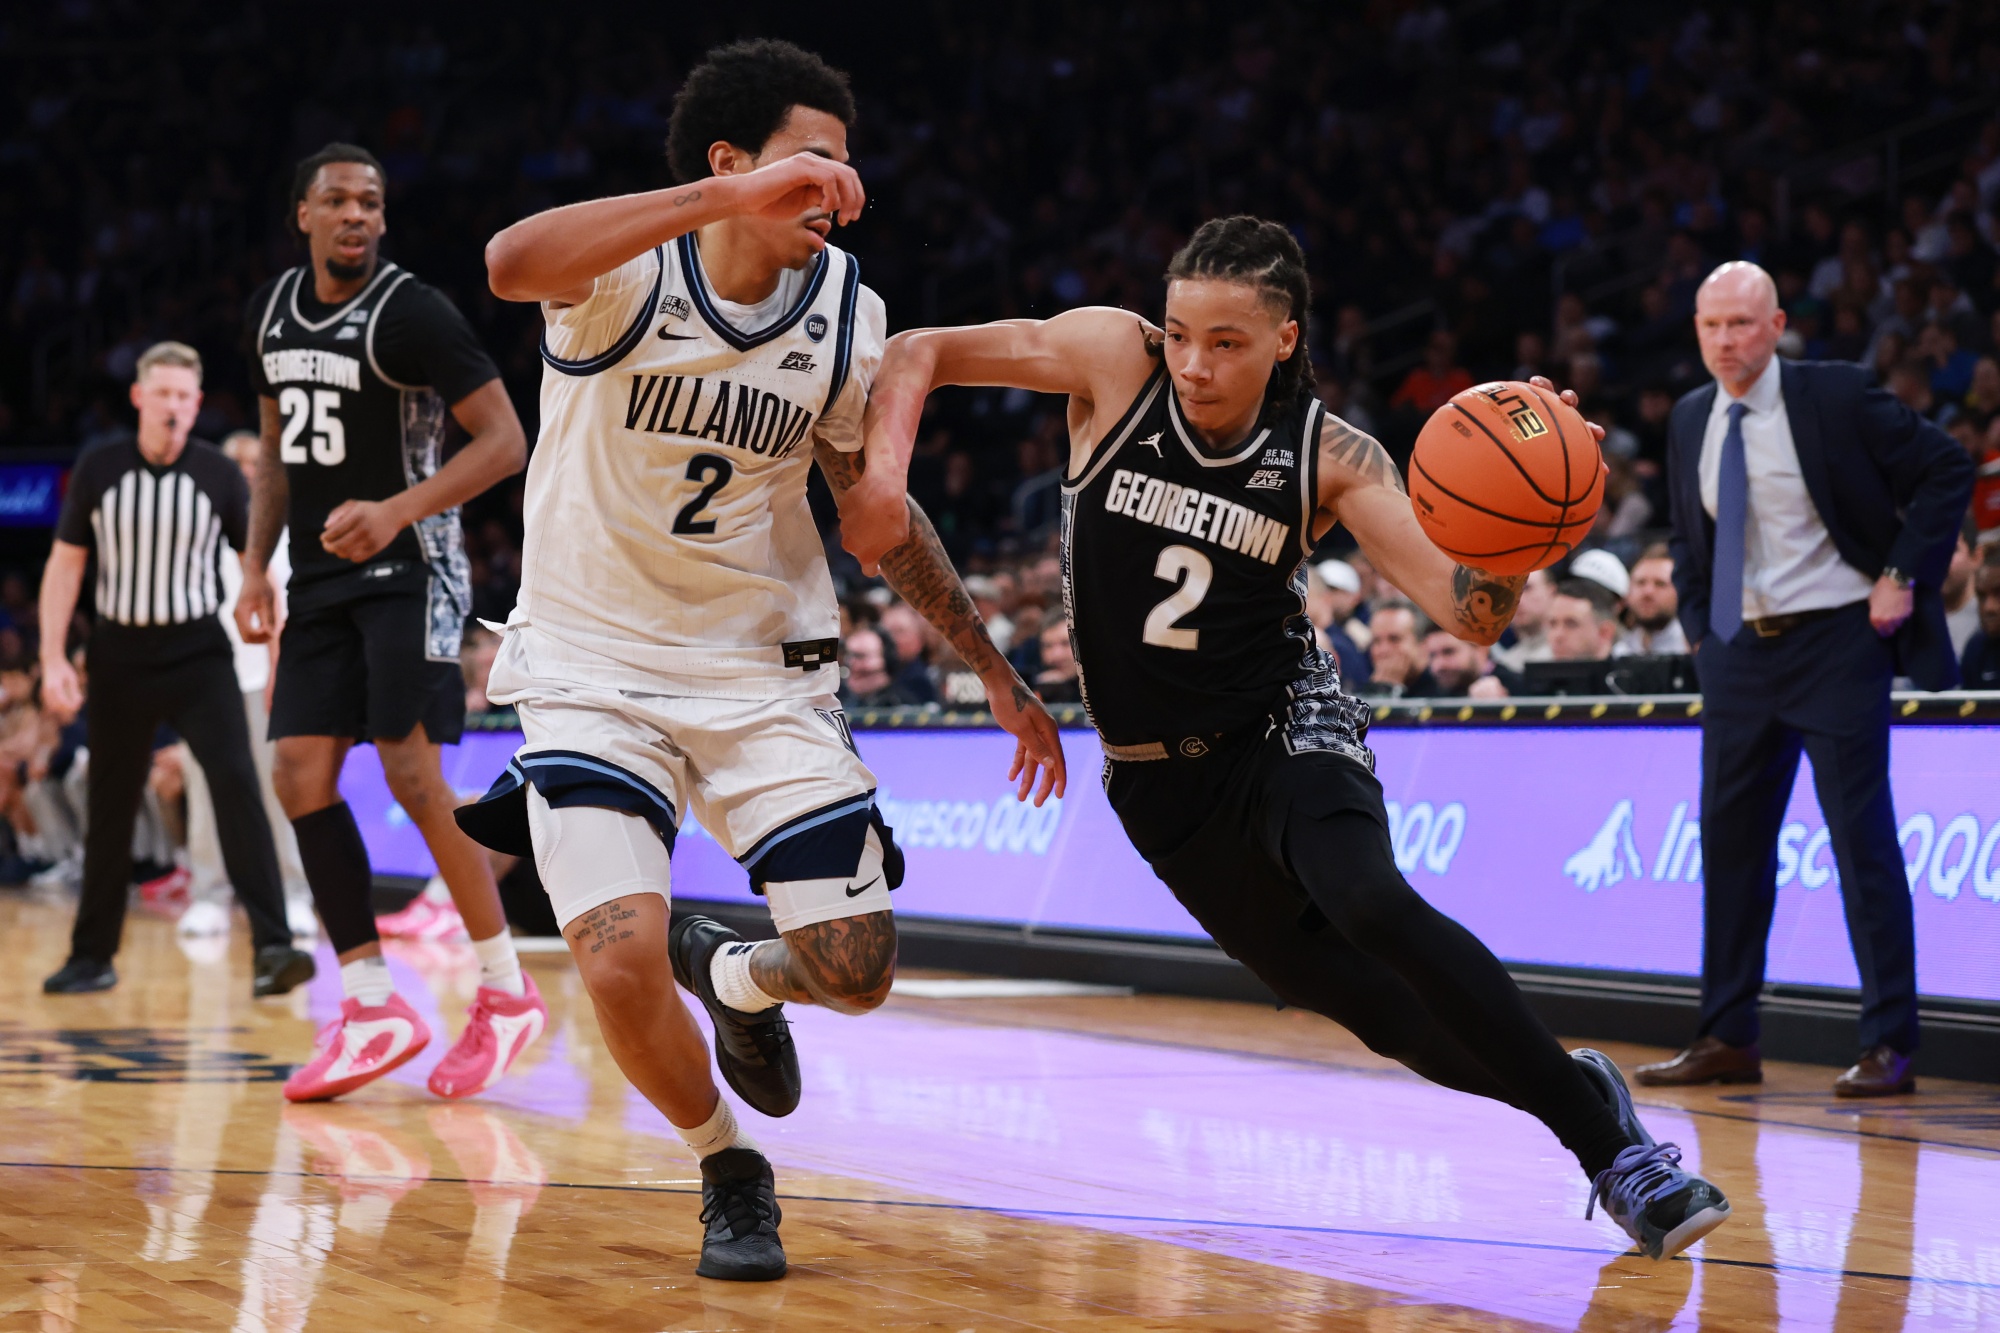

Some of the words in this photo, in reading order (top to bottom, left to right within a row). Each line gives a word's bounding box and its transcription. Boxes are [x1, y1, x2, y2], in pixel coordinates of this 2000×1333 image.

[664, 295, 678, 306] BE
[809, 321, 824, 335] GHR
[786, 351, 813, 362] BIG
[262, 349, 361, 391] GEORGETOWN
[781, 358, 817, 371] EAST
[625, 375, 813, 458] VILLANOVA
[279, 387, 346, 466] 25
[1265, 449, 1278, 457] BE
[1280, 450, 1294, 460] THE
[1261, 457, 1295, 468] CHANGE
[1253, 469, 1282, 479] BIG
[1248, 477, 1287, 488] EAST
[671, 452, 733, 535] 2
[1105, 468, 1290, 566] GEORGETOWN
[1142, 544, 1213, 650] 2
[1652, 800, 1841, 890] Insc
[604, 925, 615, 934] MY
[607, 935, 617, 943] TO
